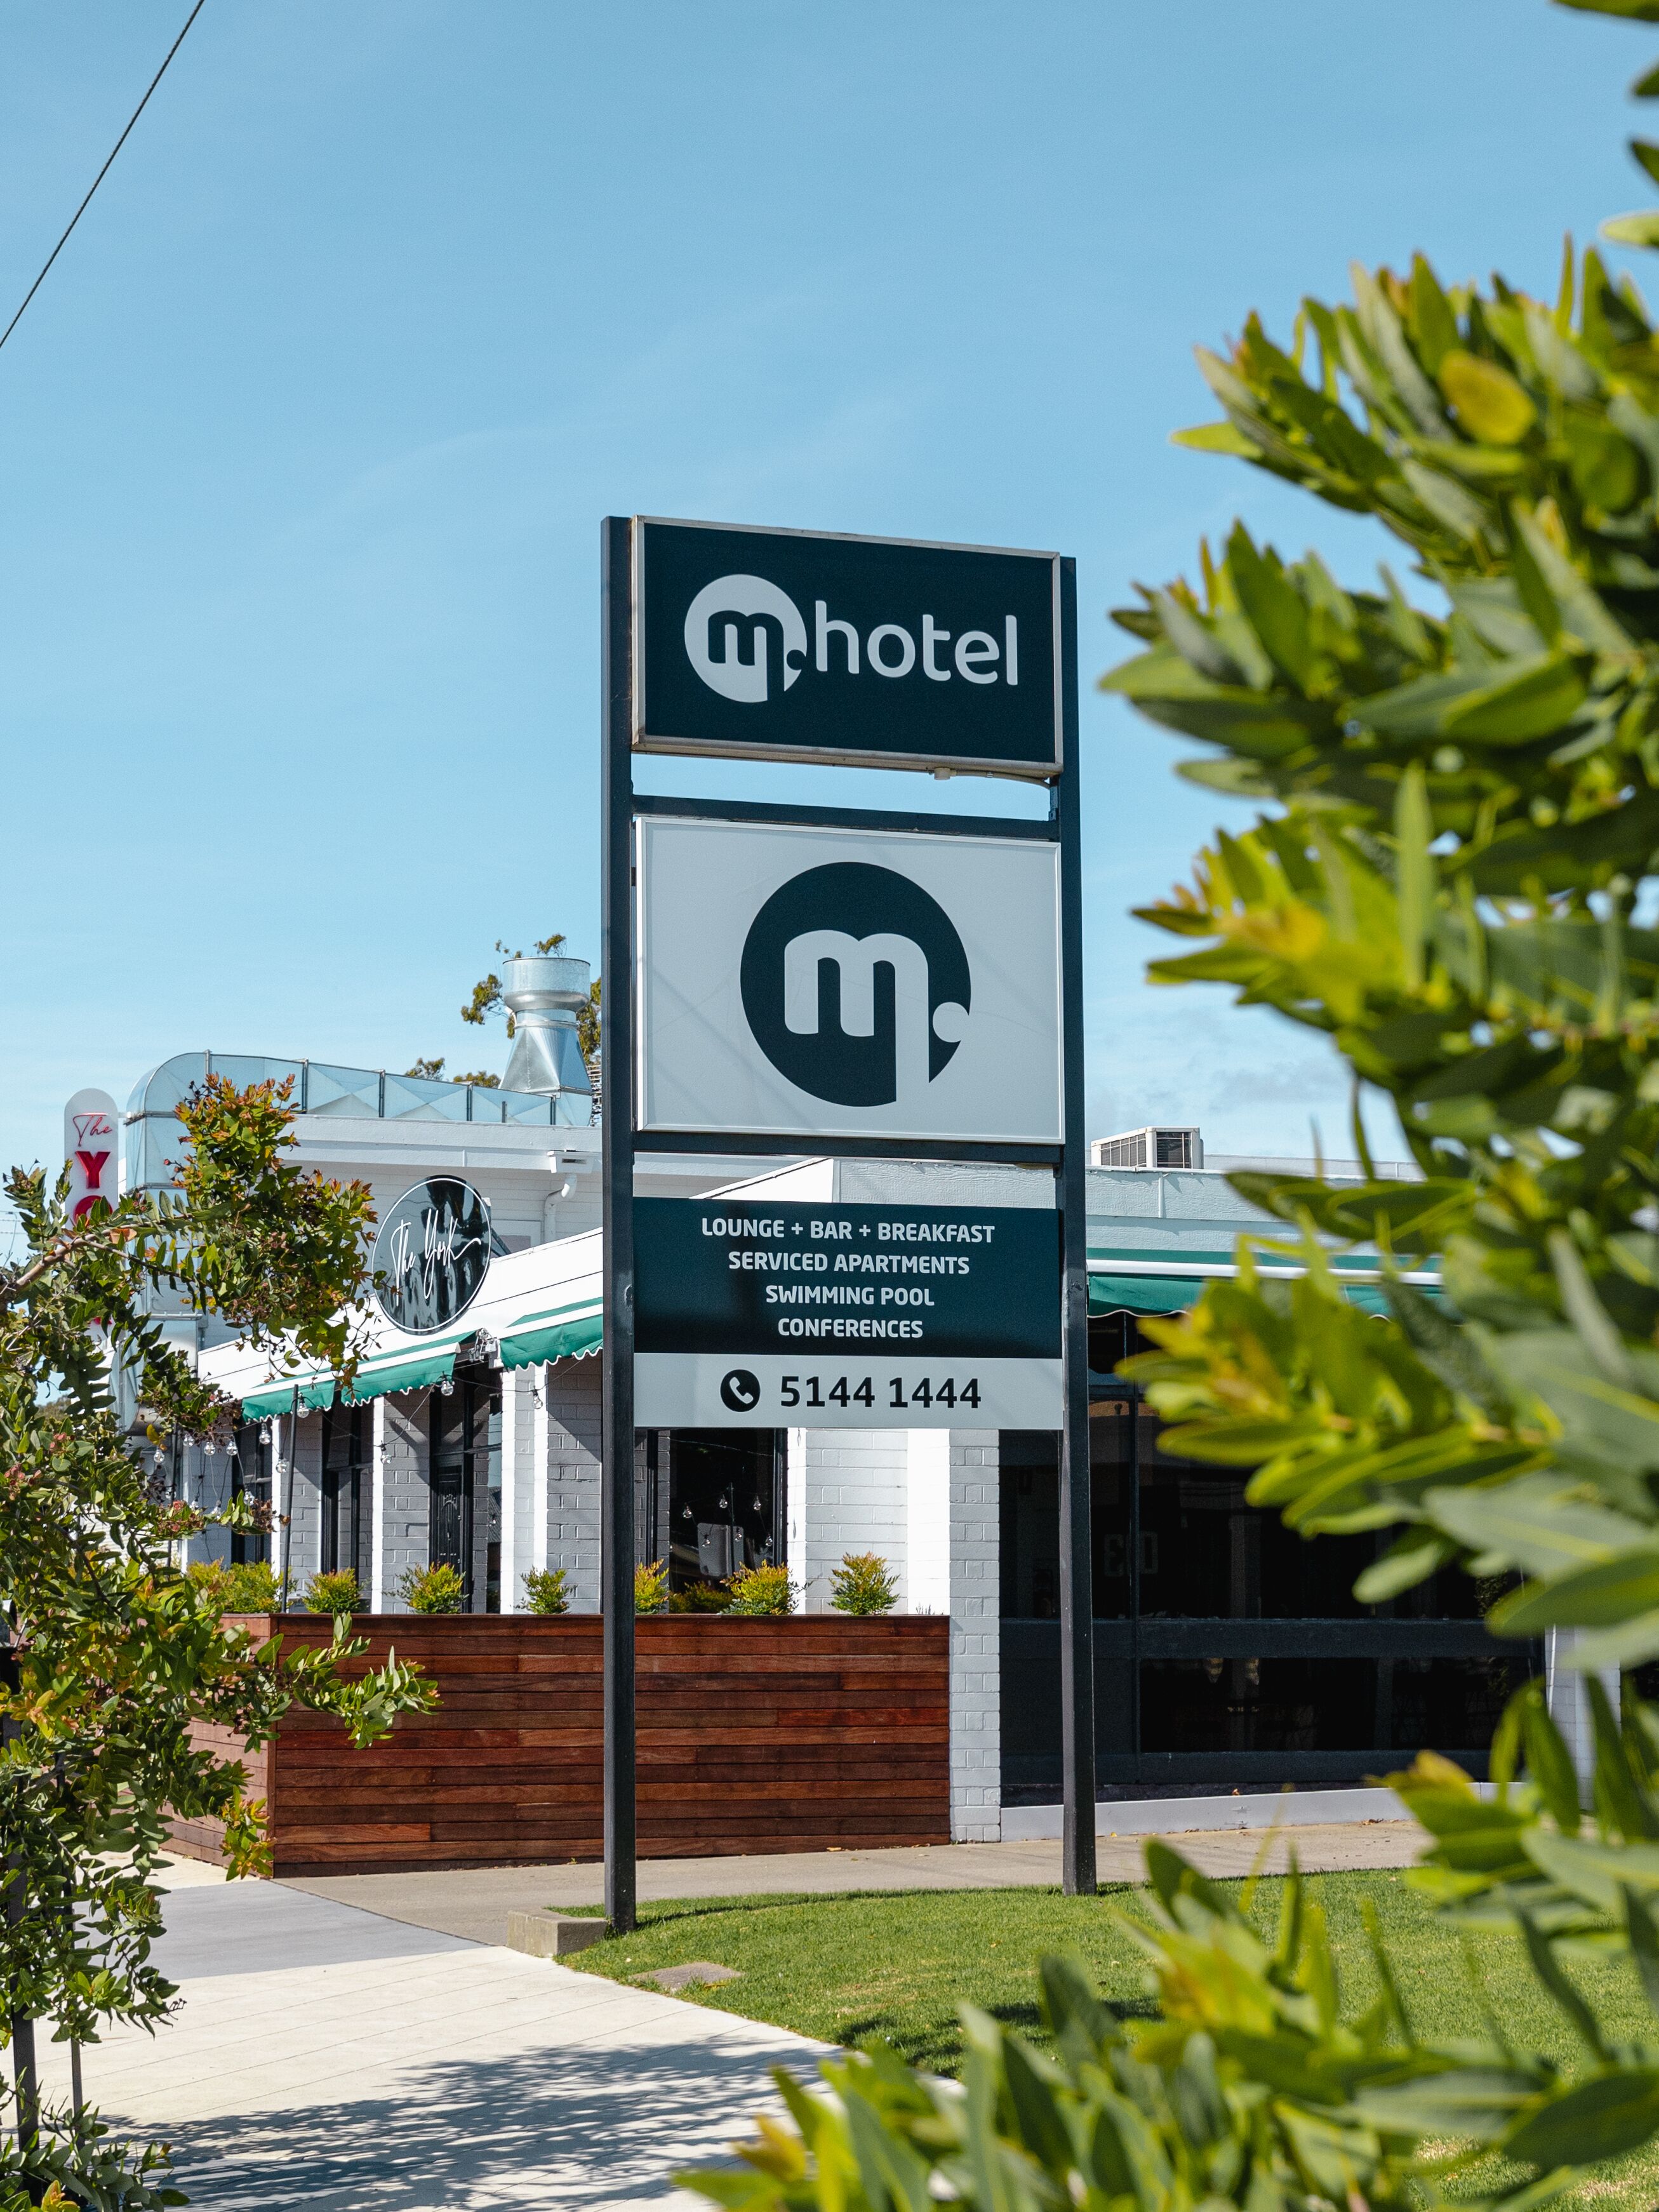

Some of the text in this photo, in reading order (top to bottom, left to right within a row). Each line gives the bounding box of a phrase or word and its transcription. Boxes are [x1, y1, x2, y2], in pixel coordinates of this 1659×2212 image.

[815, 600, 1018, 686] hotel
[72, 1112, 112, 1147] The
[702, 1218, 785, 1238] LOUNGE
[810, 1220, 853, 1239] BAR
[877, 1222, 996, 1243] BREAKFAST
[390, 1208, 482, 1307] The York
[728, 1251, 970, 1275] SERVICED APARTMENTS
[766, 1284, 935, 1306] SWIMMING POOL
[778, 1317, 923, 1338] CONFERENCES
[780, 1375, 982, 1409] 5144 1444
